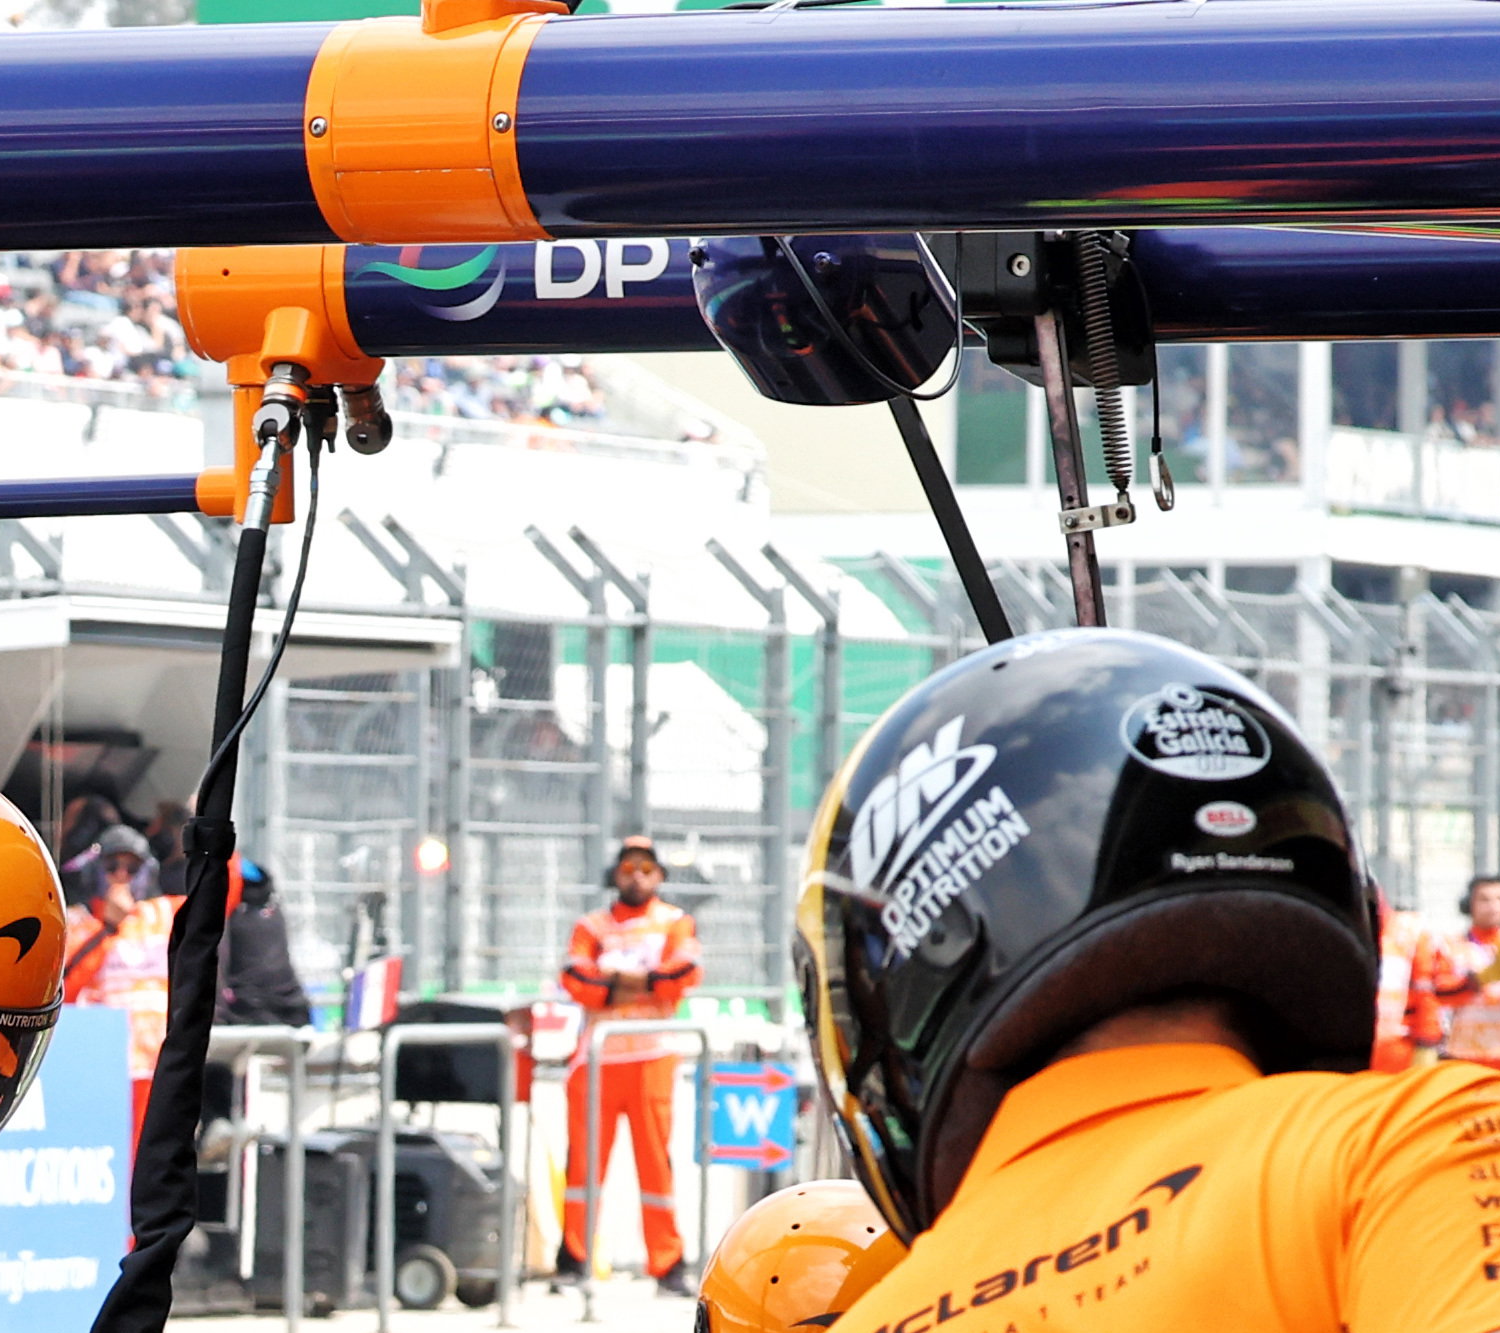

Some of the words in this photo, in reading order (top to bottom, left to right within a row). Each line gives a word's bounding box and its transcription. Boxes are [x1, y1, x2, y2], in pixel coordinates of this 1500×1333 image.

[534, 239, 670, 299] DP
[1145, 709, 1244, 732] Estrella
[1155, 728, 1251, 755] Galicia
[849, 714, 966, 893] ON
[1206, 810, 1249, 824] BELL
[882, 786, 1014, 936] OPTIMUM
[1171, 853, 1214, 873] Ryan
[892, 811, 1031, 960] NUTRITION
[0, 1014, 47, 1028] NUTRITION
[724, 1093, 780, 1138] W
[1075, 1257, 1151, 1310] TEAM
